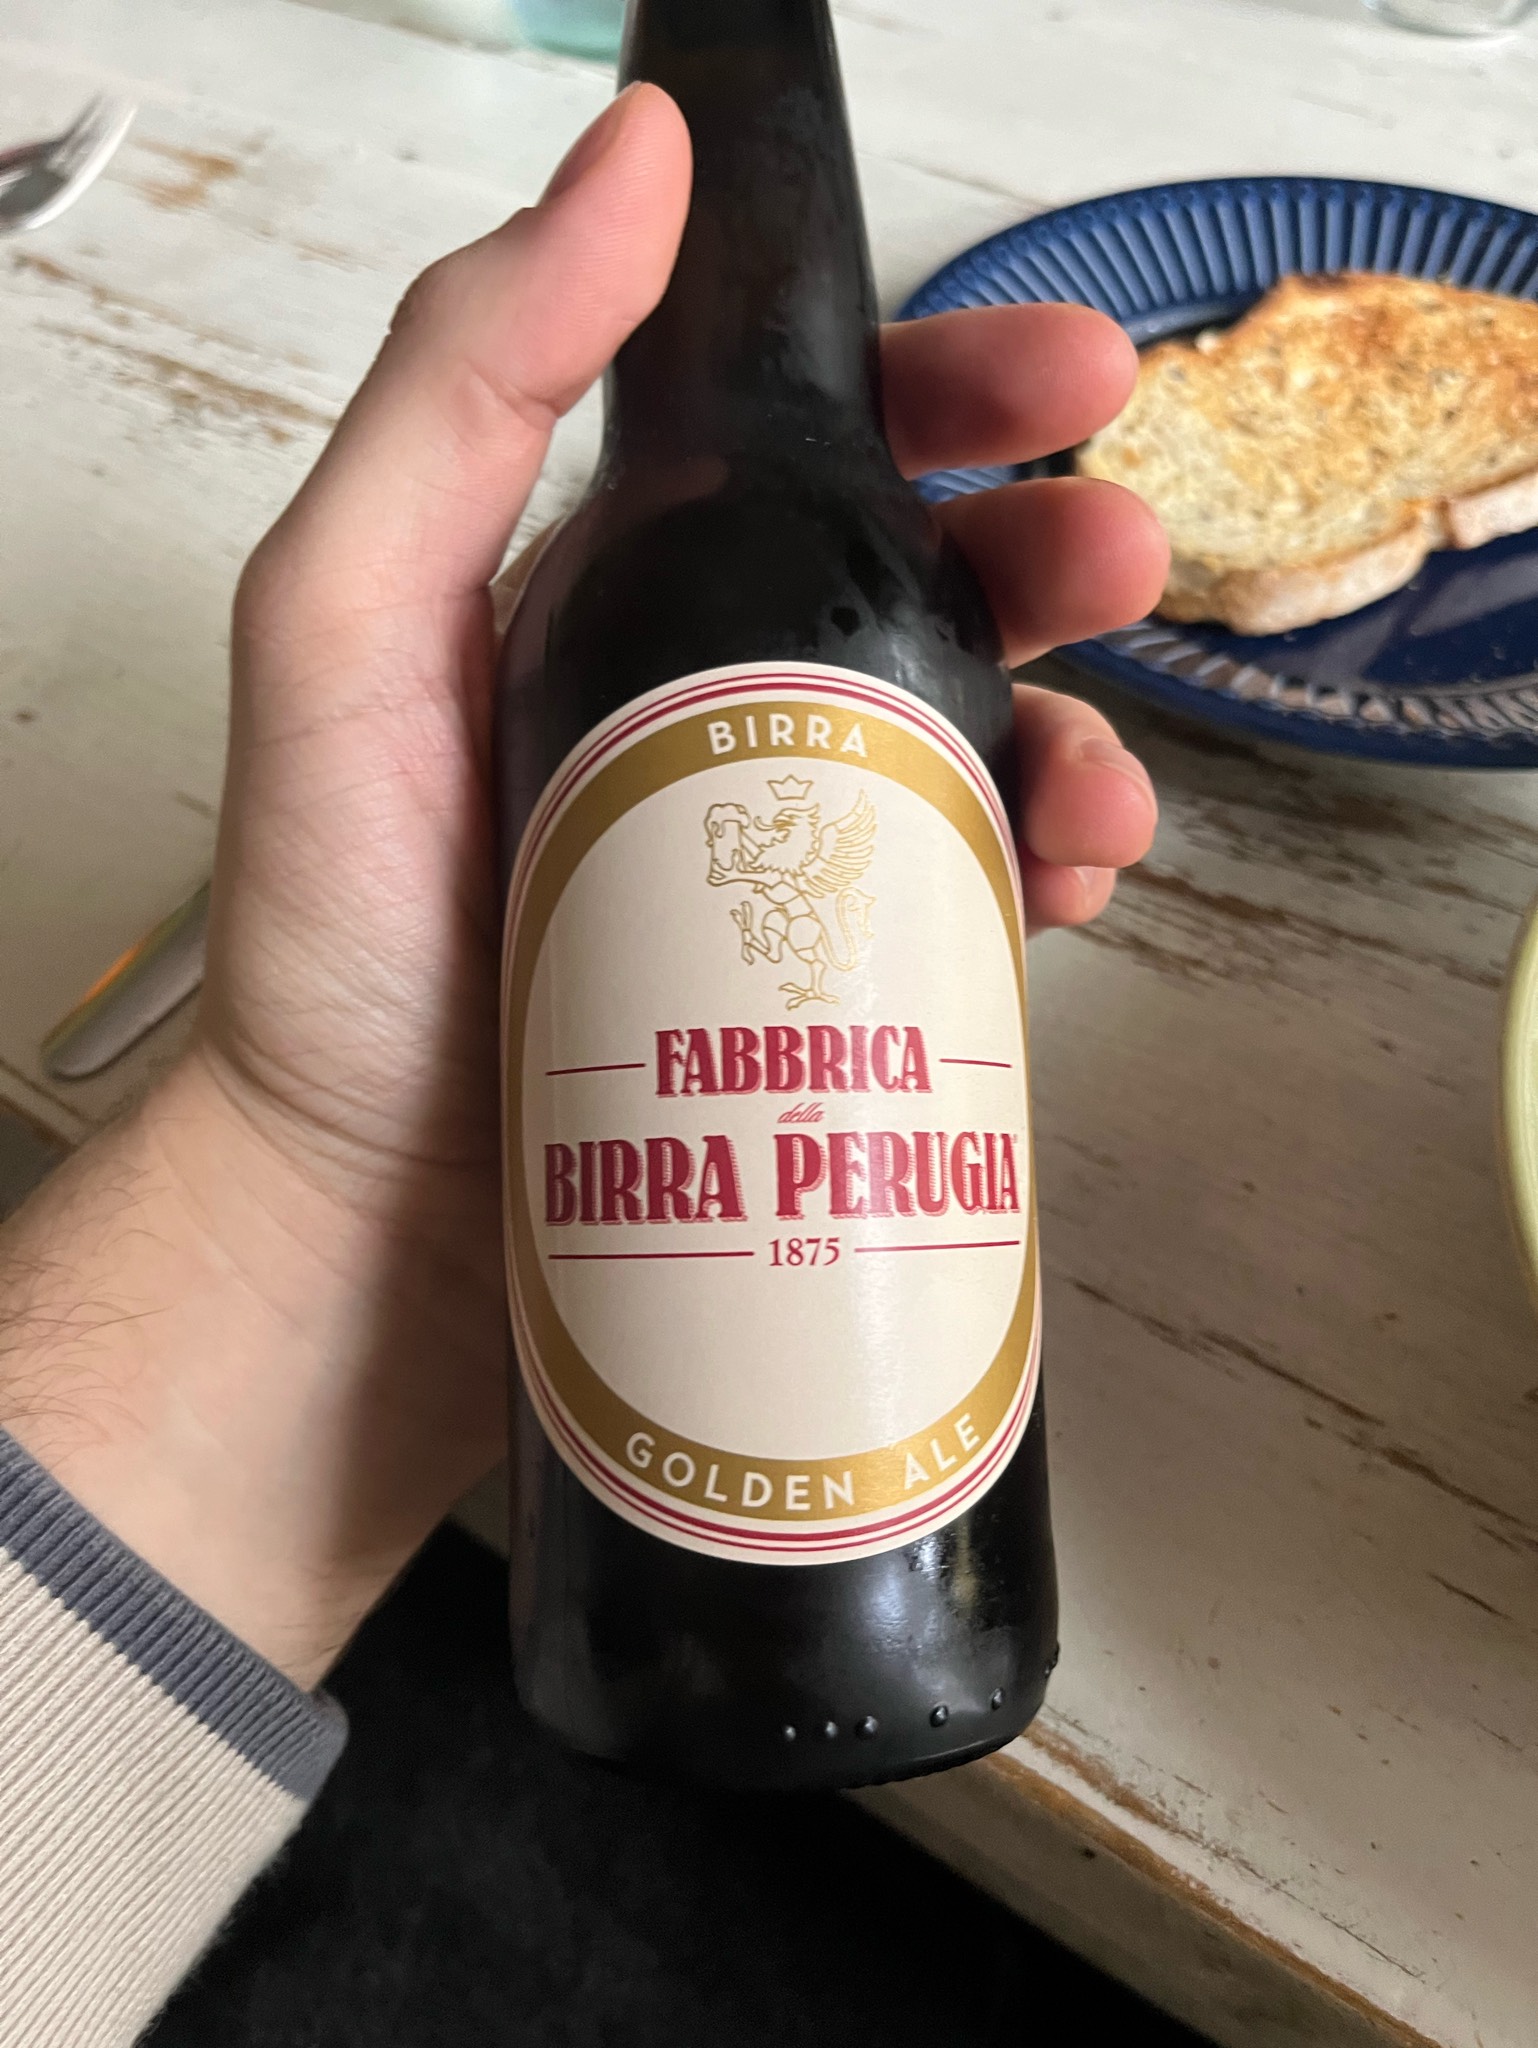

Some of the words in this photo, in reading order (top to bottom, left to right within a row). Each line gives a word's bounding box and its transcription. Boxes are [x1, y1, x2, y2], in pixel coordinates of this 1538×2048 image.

[707, 713, 867, 757] BIRRA
[656, 1025, 933, 1097] FABBRICA
[777, 1102, 826, 1124] della
[544, 1134, 748, 1226] BIRRA
[774, 1131, 1020, 1220] PERUGIA
[768, 1237, 841, 1267] 1875
[626, 1432, 855, 1510] GOLDEN
[903, 1413, 981, 1489] ALE
